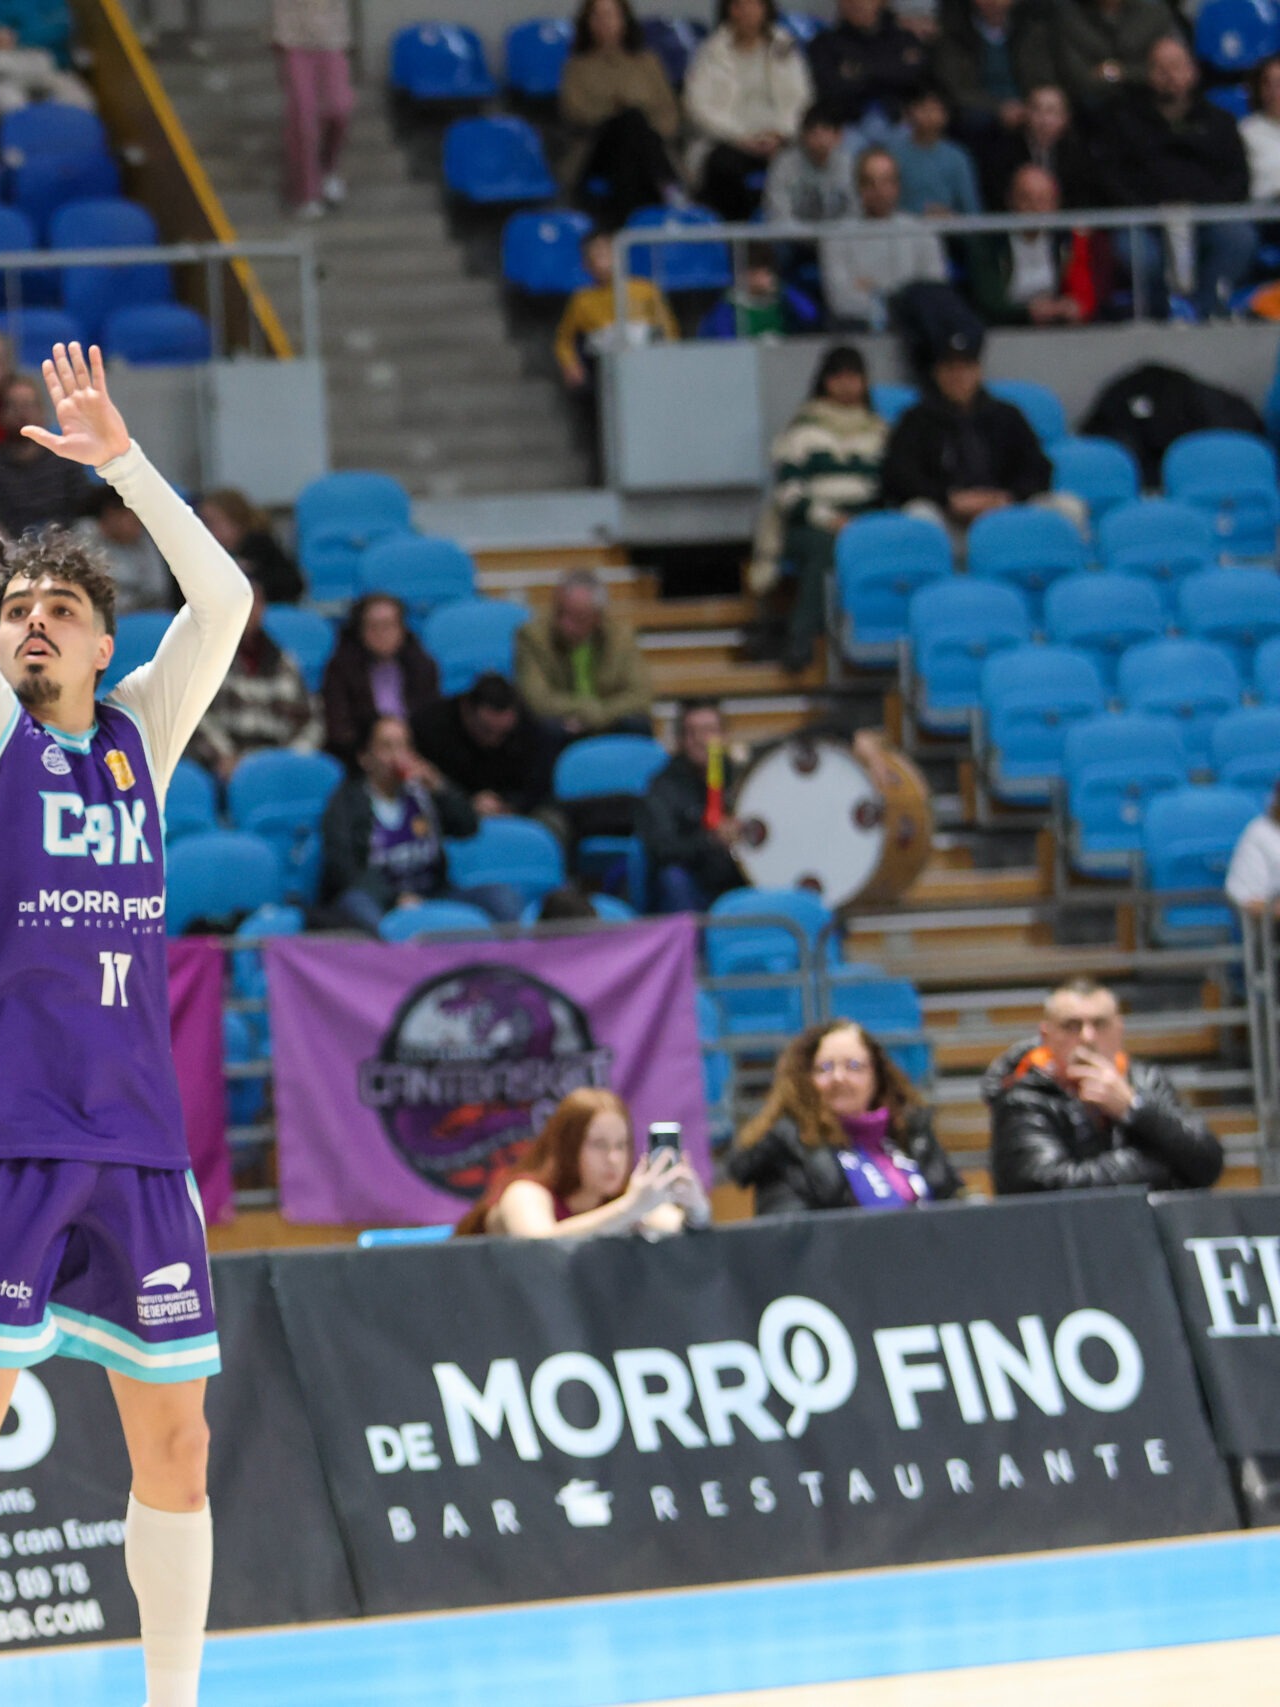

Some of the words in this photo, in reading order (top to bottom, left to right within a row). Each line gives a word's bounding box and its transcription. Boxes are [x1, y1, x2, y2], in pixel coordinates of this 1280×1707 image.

[18, 901, 36, 913] DE
[39, 889, 120, 914] MORR
[18, 918, 51, 928] BAR
[365, 1422, 441, 1474] DE
[432, 1295, 858, 1466] MORRO
[873, 1308, 1144, 1430] FINO
[387, 1499, 521, 1542] BAR
[649, 1438, 1172, 1522] RESTAURANTE
[13, 1527, 64, 1557] con
[62, 1518, 128, 1550] Euro
